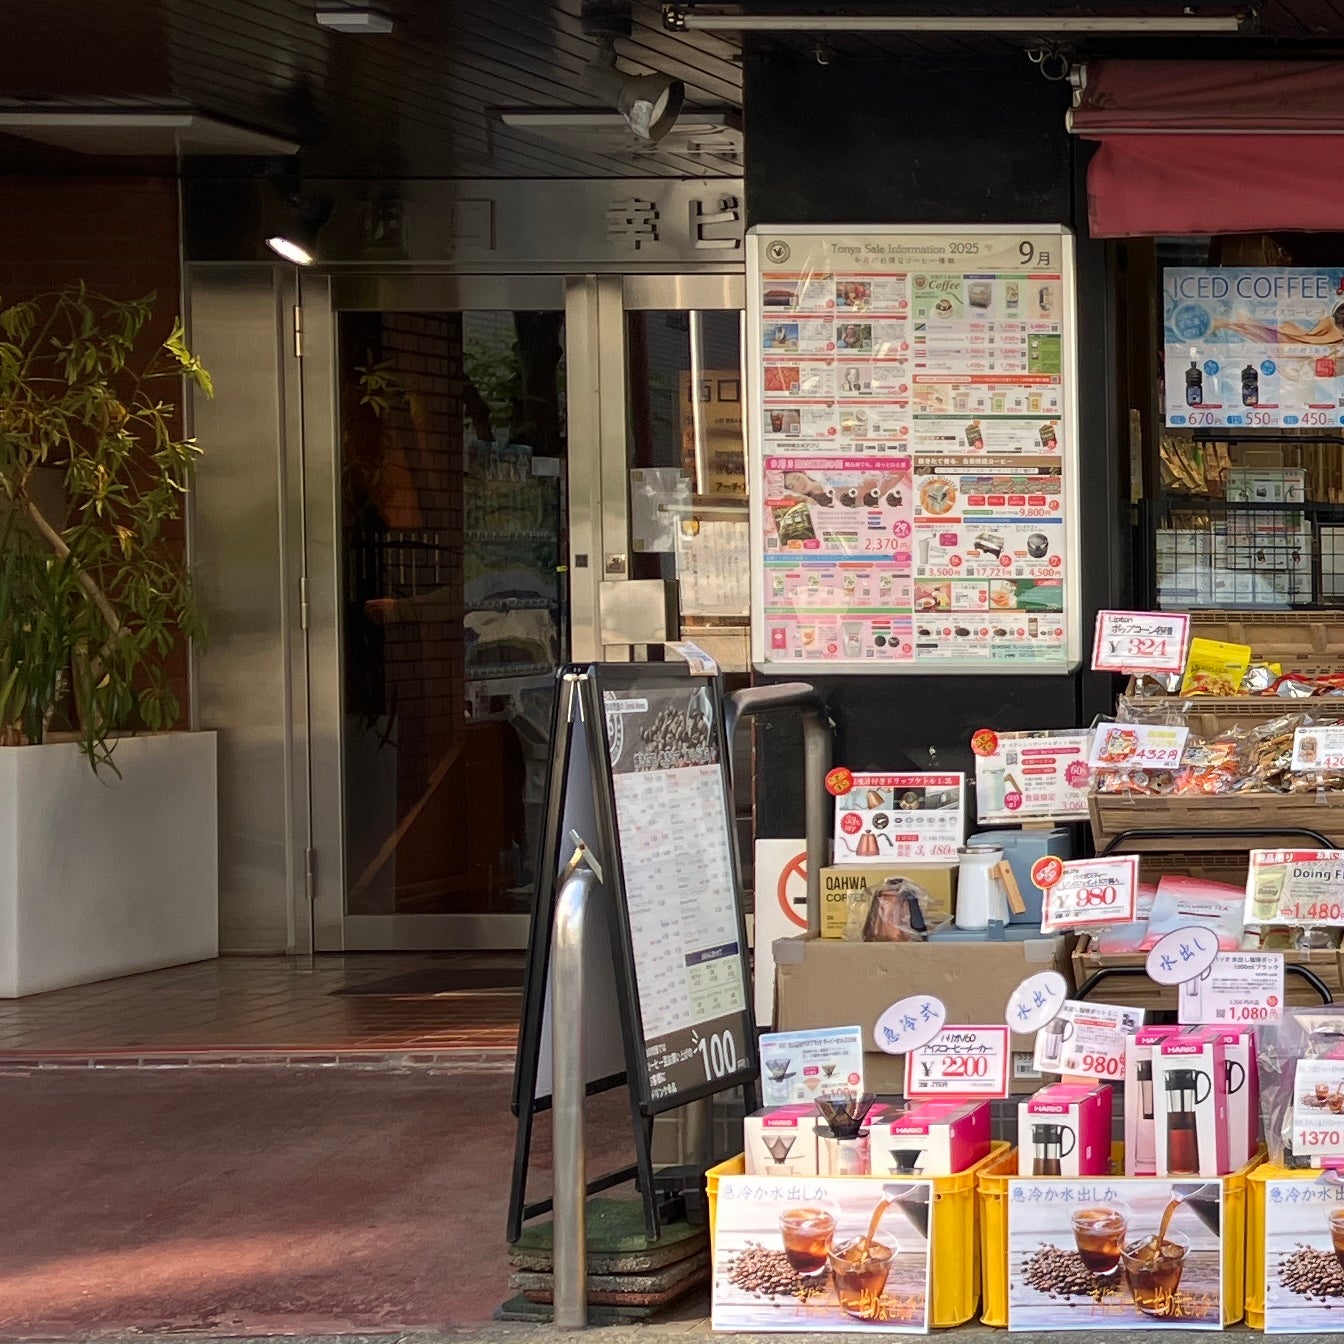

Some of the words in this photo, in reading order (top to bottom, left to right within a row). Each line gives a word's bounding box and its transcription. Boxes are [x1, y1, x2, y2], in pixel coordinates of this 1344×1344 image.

[831, 243, 861, 256] Tonya
[865, 243, 886, 254] Sale
[888, 243, 945, 254] Information
[949, 242, 980, 255] 2025
[1173, 276, 1229, 299] ICED
[1236, 276, 1328, 299] COFFEE
[1128, 638, 1167, 656] 324
[1136, 749, 1178, 761] 432円
[825, 876, 867, 890] QAHWA
[1293, 867, 1331, 882] Doing
[1076, 886, 1117, 907] 980
[1159, 938, 1207, 972] 水出し
[1017, 983, 1056, 1019] 水出し
[1166, 1046, 1197, 1054] HARIO
[921, 1060, 934, 1077] ¥
[942, 1055, 988, 1077] 2200
[1082, 1054, 1118, 1075] 980
[1033, 1105, 1063, 1113] HARIO
[896, 1126, 924, 1134] HARIO
[1013, 1186, 1118, 1203] 急冷か水出しか
